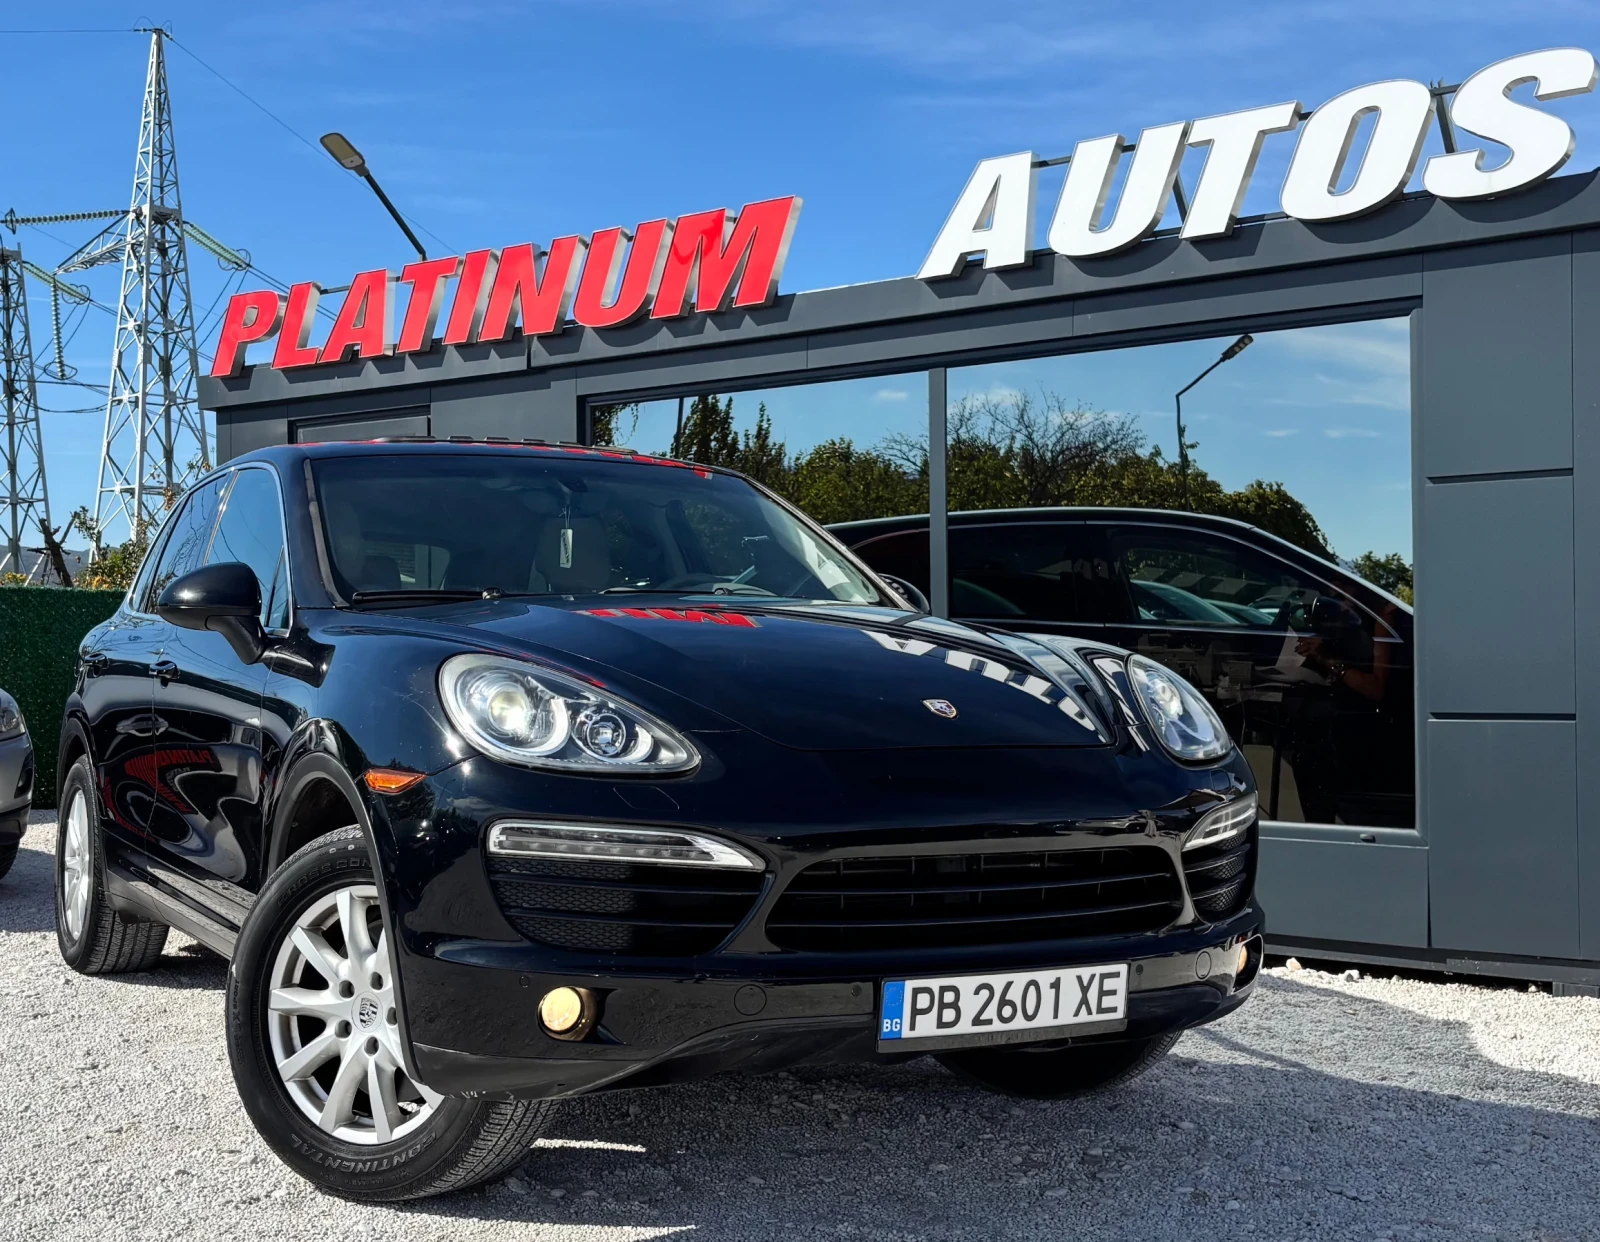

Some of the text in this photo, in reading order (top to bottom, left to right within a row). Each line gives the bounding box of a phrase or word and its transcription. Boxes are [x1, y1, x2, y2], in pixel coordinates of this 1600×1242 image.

[211, 46, 1598, 377] PLATINUM AUTOS
[232, 978, 240, 1010] SPORT
[909, 971, 1121, 1031] PB 2601 XE
[883, 1019, 901, 1032] BG
[291, 1130, 437, 1173] CONTINENTAL
